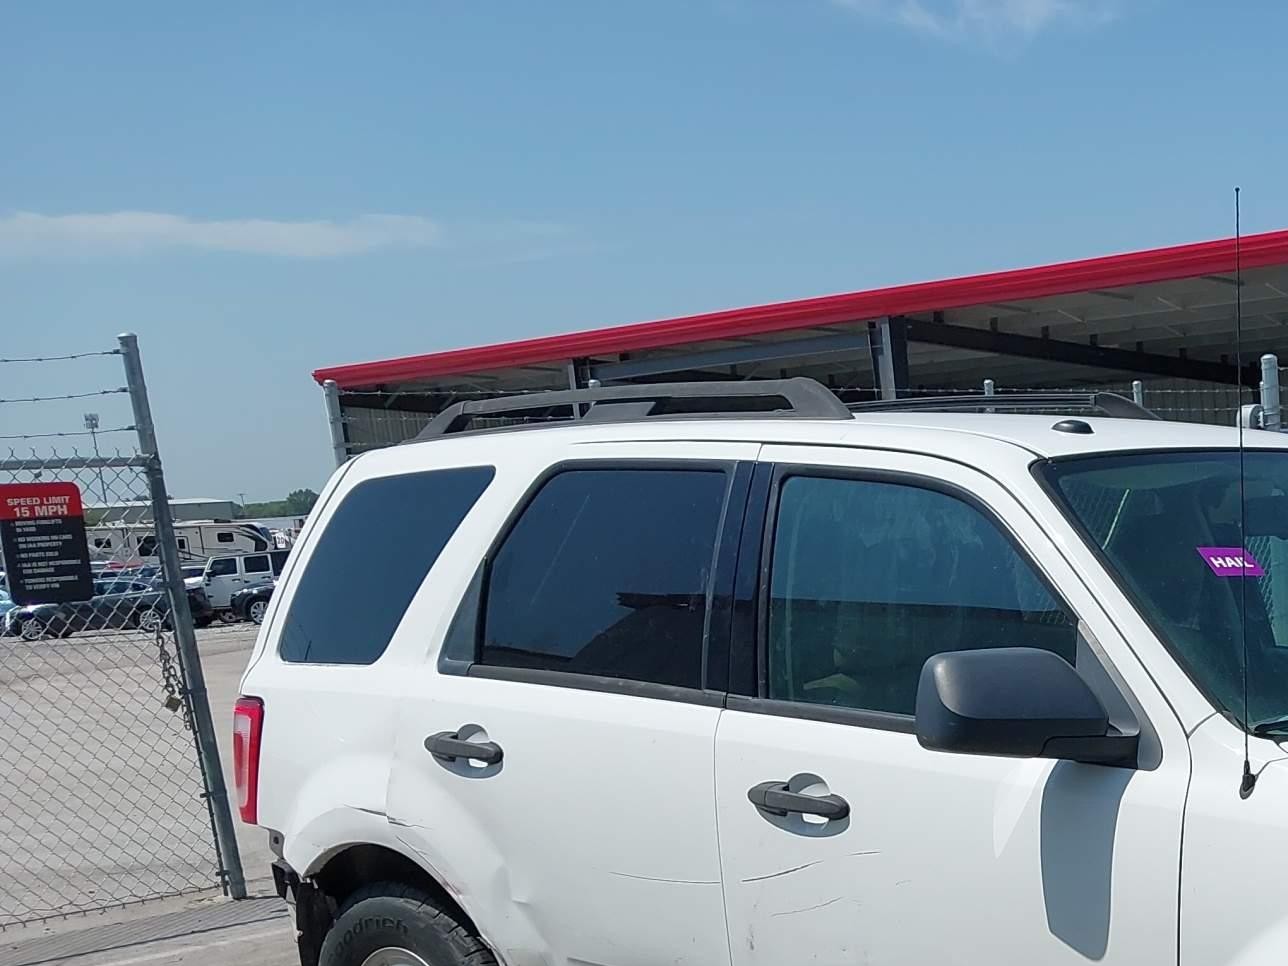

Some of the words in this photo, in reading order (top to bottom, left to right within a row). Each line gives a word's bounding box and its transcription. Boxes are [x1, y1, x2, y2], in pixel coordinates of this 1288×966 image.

[7, 498, 40, 506] SPEED
[43, 496, 70, 504] LIMIT
[13, 507, 30, 517] 15
[34, 505, 68, 517] MPH
[1210, 556, 1255, 568] HAIL
